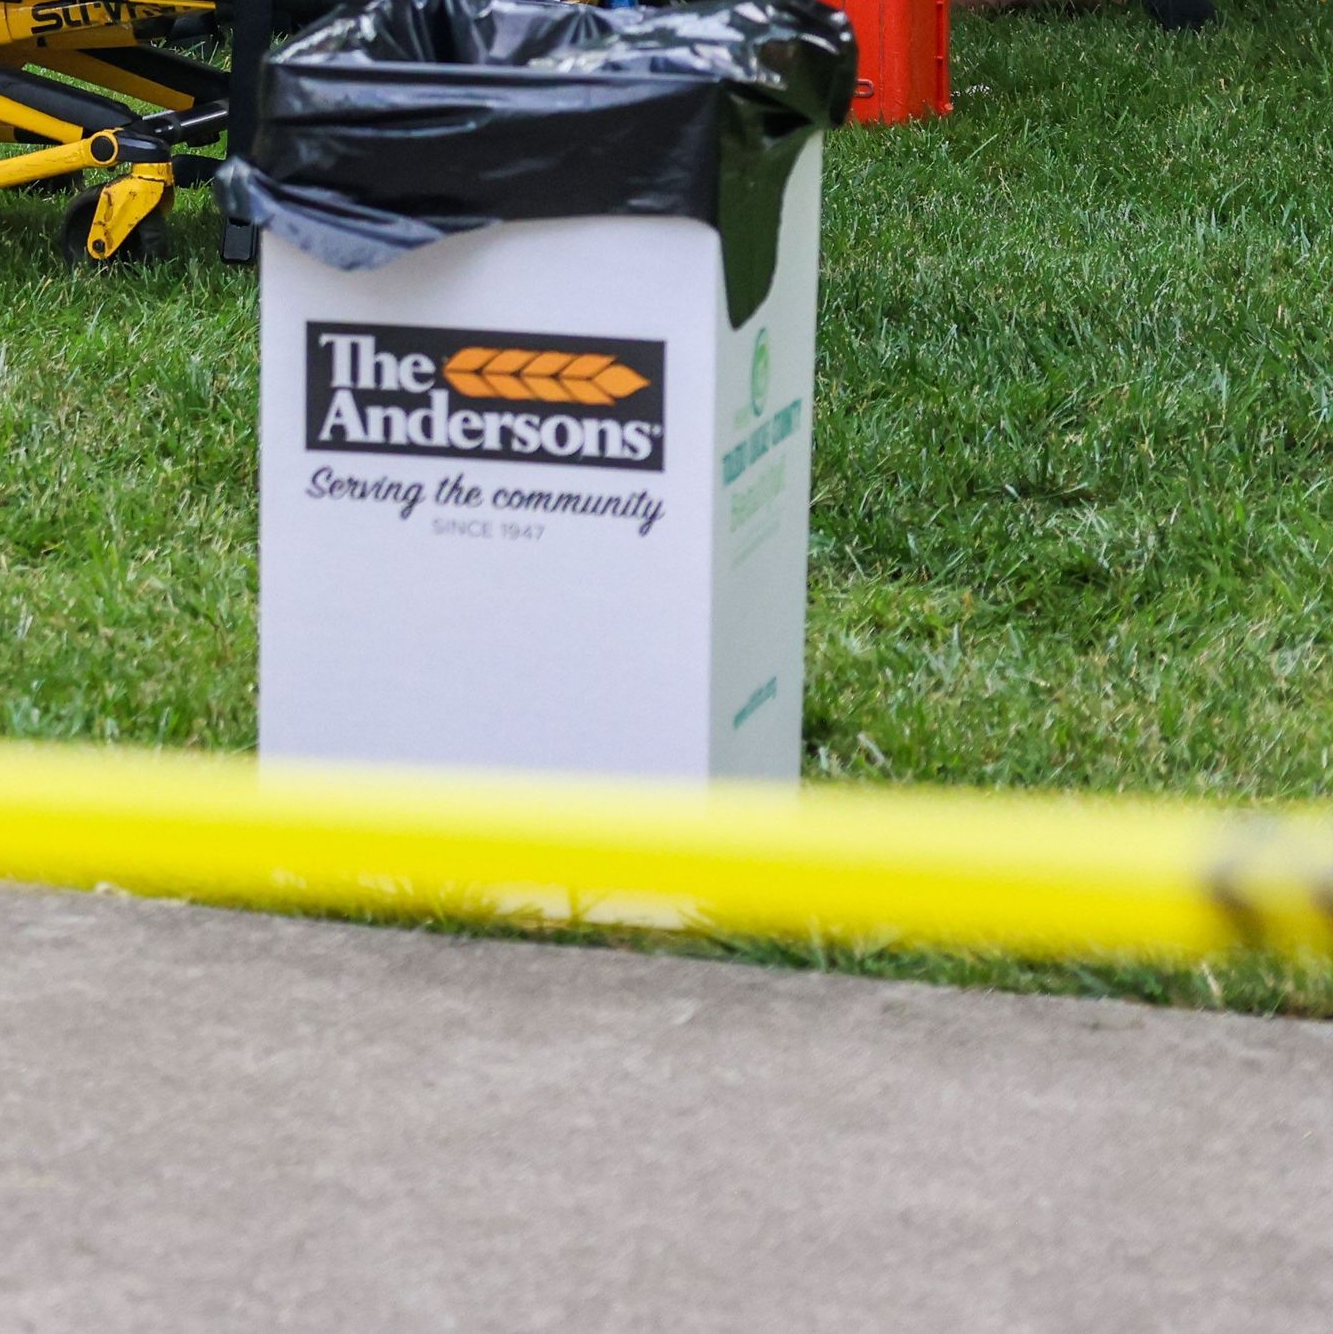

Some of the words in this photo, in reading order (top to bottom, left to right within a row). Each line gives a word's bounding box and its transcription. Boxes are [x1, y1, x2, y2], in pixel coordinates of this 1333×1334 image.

[318, 332, 435, 394] The
[318, 388, 655, 462] Andersons
[305, 466, 425, 519] Serving
[433, 472, 483, 508] the
[491, 488, 665, 536] community
[432, 519, 494, 540] SINCE
[500, 523, 545, 541] 1947
